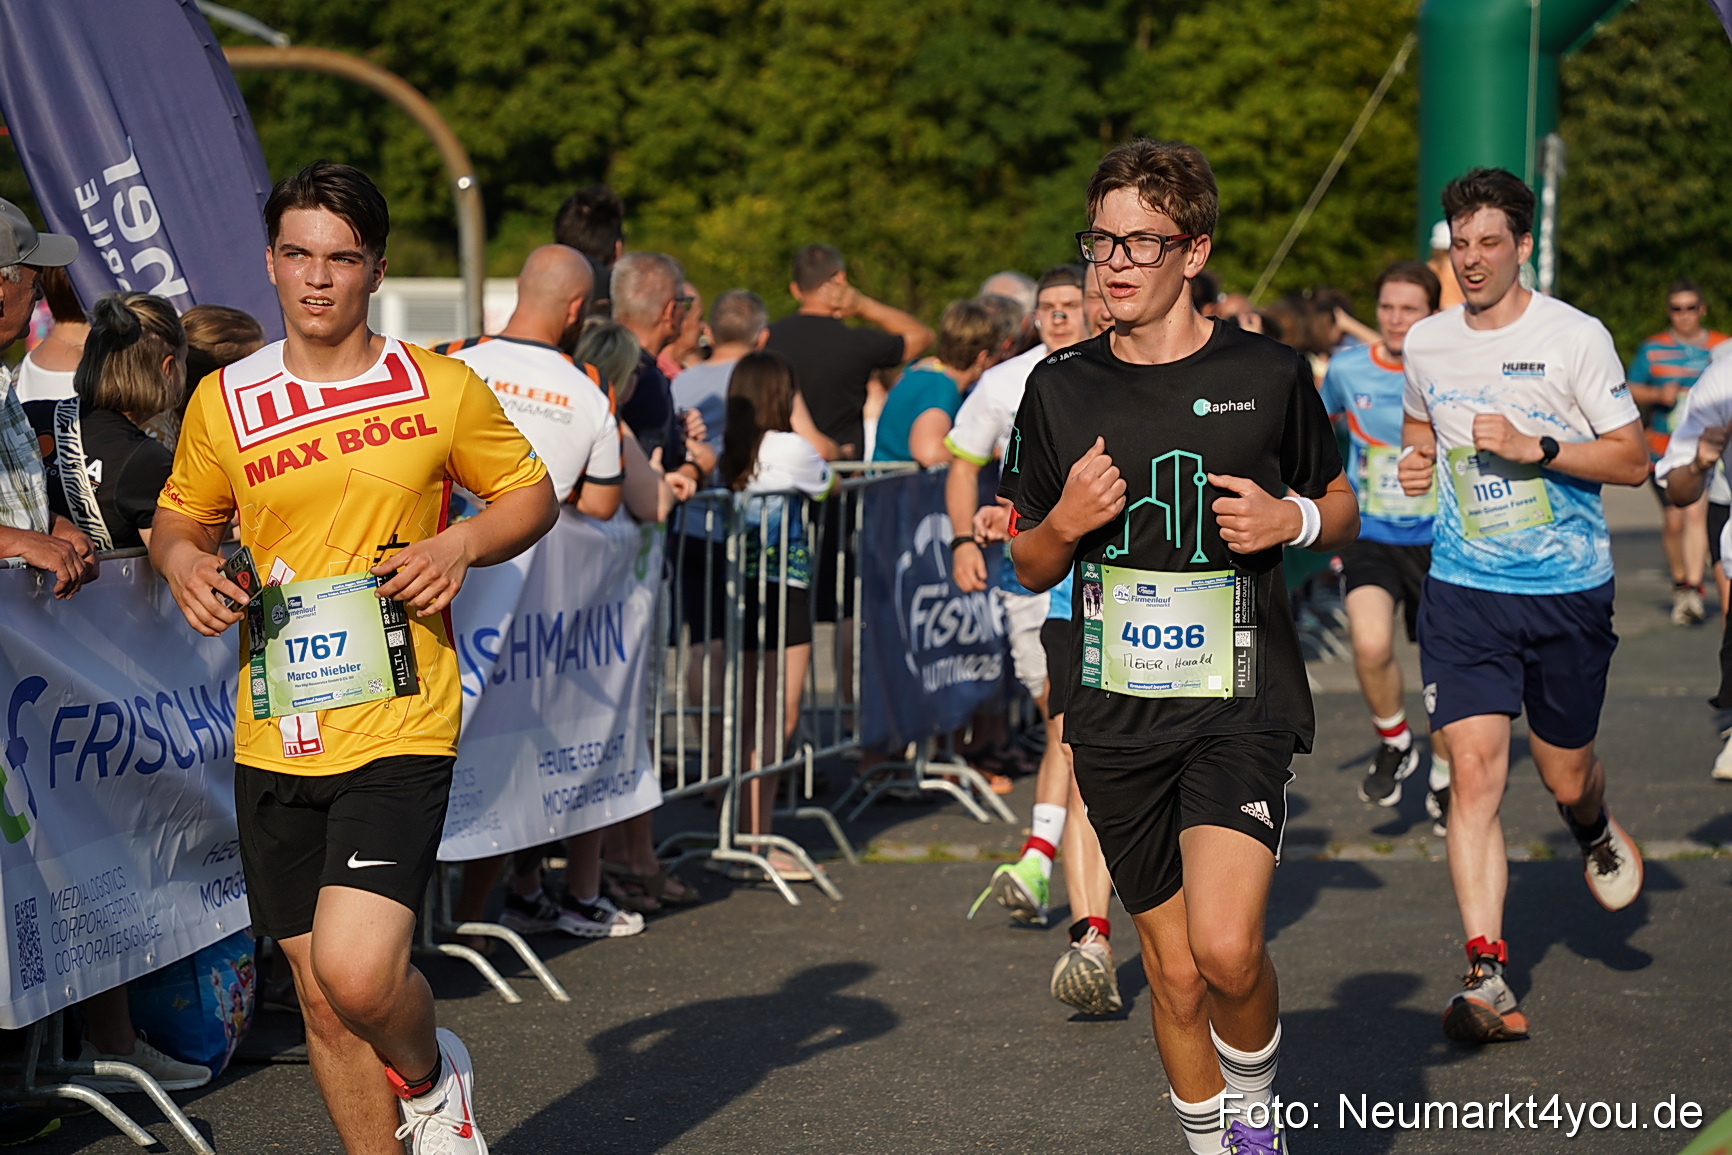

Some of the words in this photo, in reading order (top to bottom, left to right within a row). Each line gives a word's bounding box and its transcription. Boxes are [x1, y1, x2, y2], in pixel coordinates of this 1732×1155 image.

[1059, 350, 1082, 361] JAKO
[1502, 361, 1545, 371] HUBER
[1203, 399, 1256, 414] Raphael
[243, 437, 328, 488] MAX
[335, 413, 438, 455] BÖGL
[1473, 478, 1512, 502] 1161
[1084, 571, 1099, 579] AOK
[1131, 595, 1171, 604] Firmenlauf
[285, 630, 348, 664] 1767
[1121, 621, 1205, 650] 4036
[287, 670, 318, 682] Marco
[319, 663, 362, 677] Niebler
[393, 649, 407, 687] HILTL
[1174, 653, 1213, 669] Harald
[1238, 649, 1247, 688] HILTL
[536, 747, 578, 777] HEUTE
[1240, 804, 1275, 830] adidas
[51, 903, 119, 944] CORPORATE
[54, 931, 123, 976] CORPORATE
[123, 914, 162, 951] SIGNAGE
